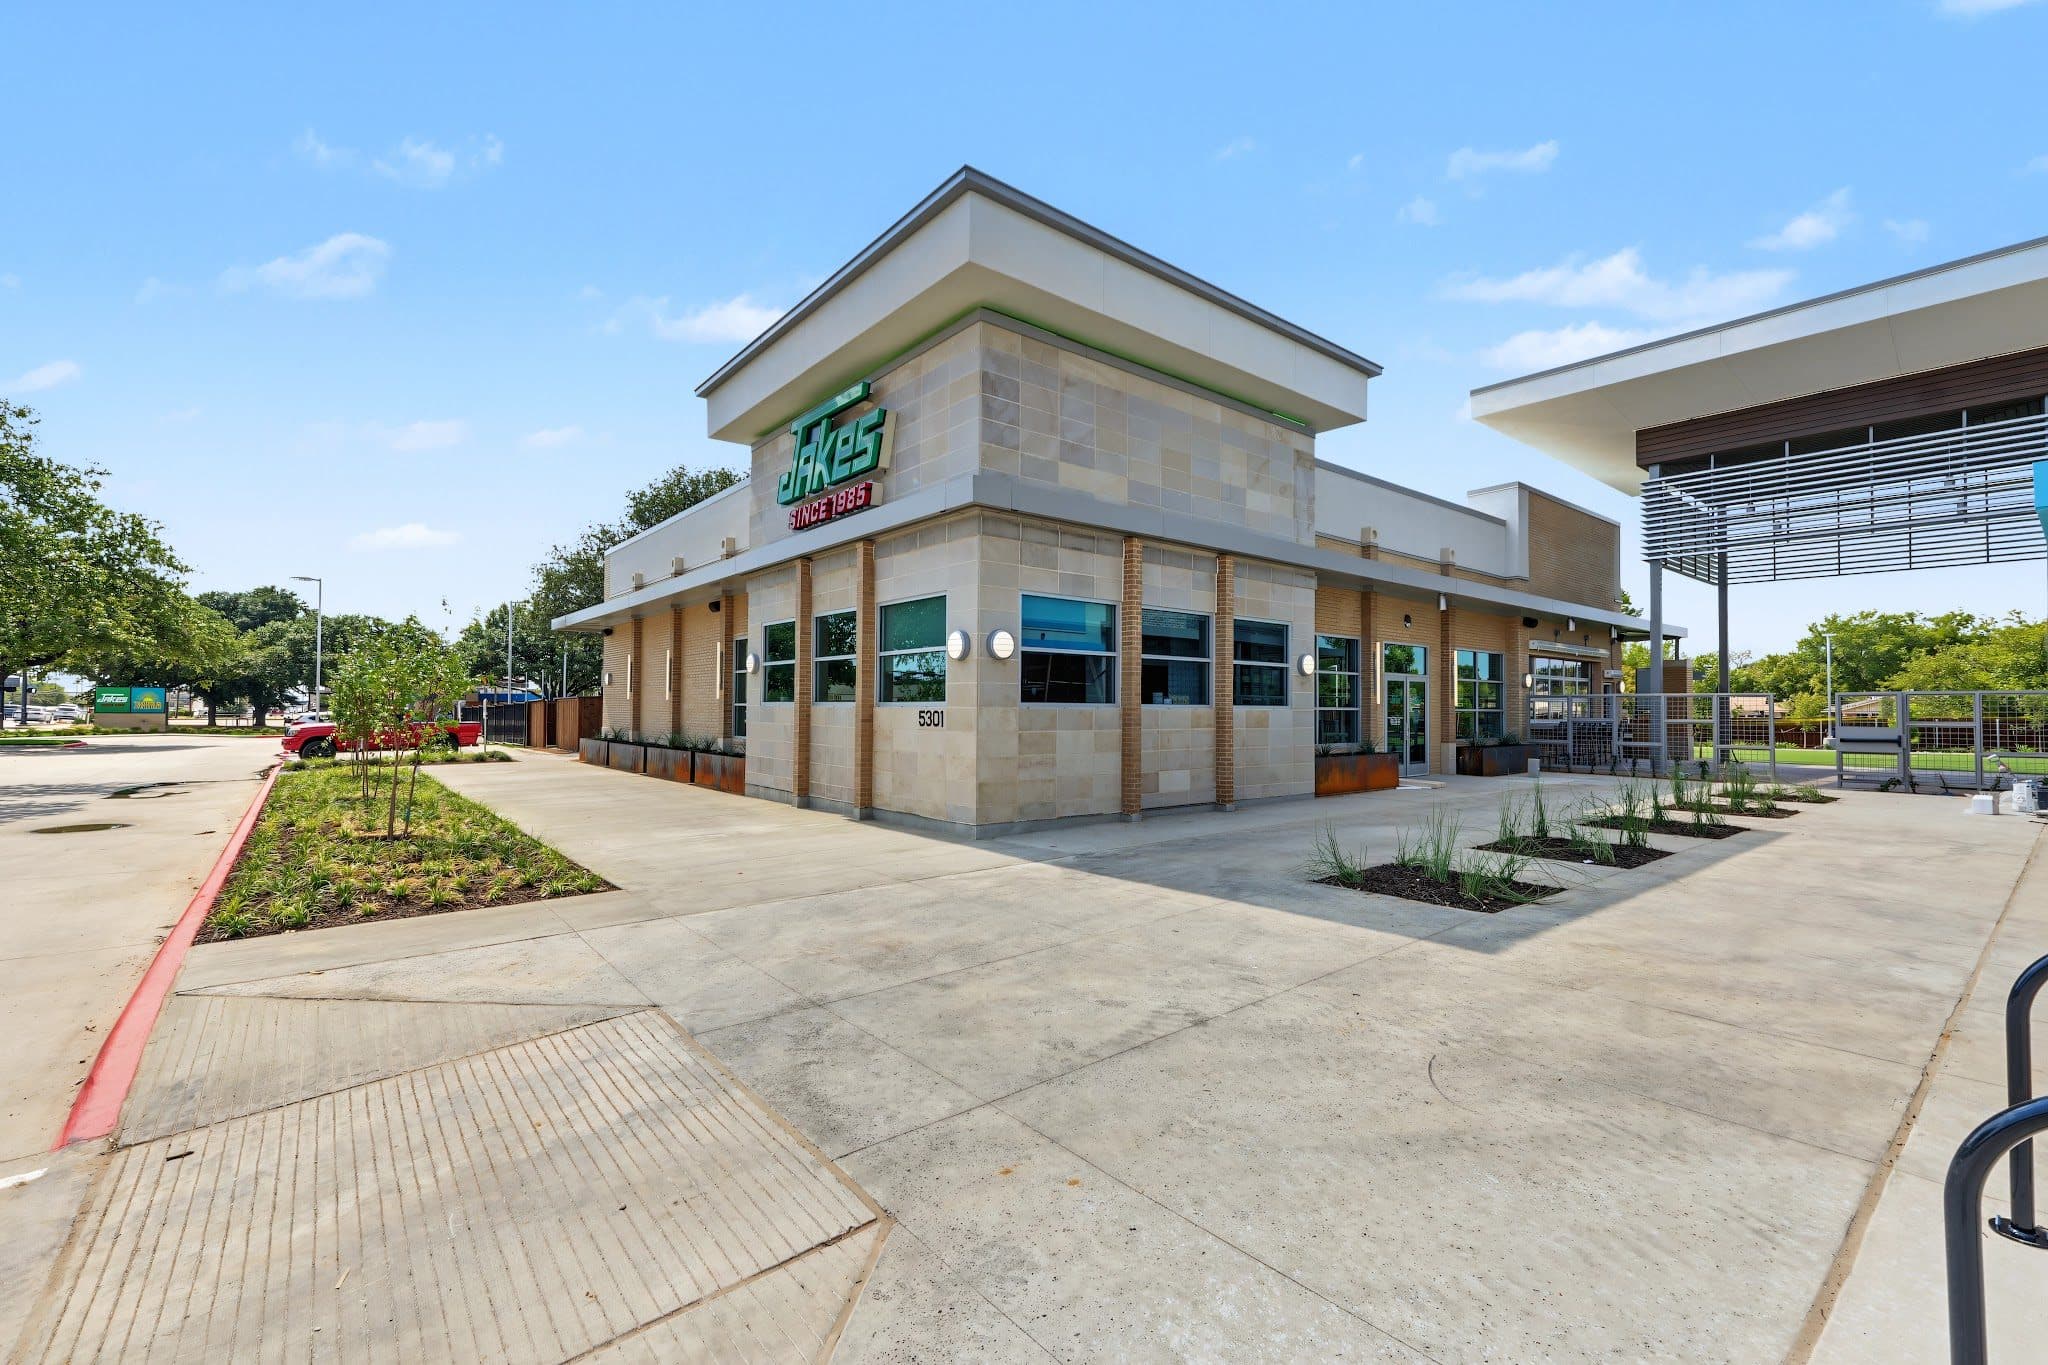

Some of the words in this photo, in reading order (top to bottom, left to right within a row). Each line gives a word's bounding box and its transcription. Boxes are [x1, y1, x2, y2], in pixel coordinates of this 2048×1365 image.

[789, 497, 831, 530] SINCE
[832, 482, 871, 515] 1985
[918, 710, 944, 727] 5301
